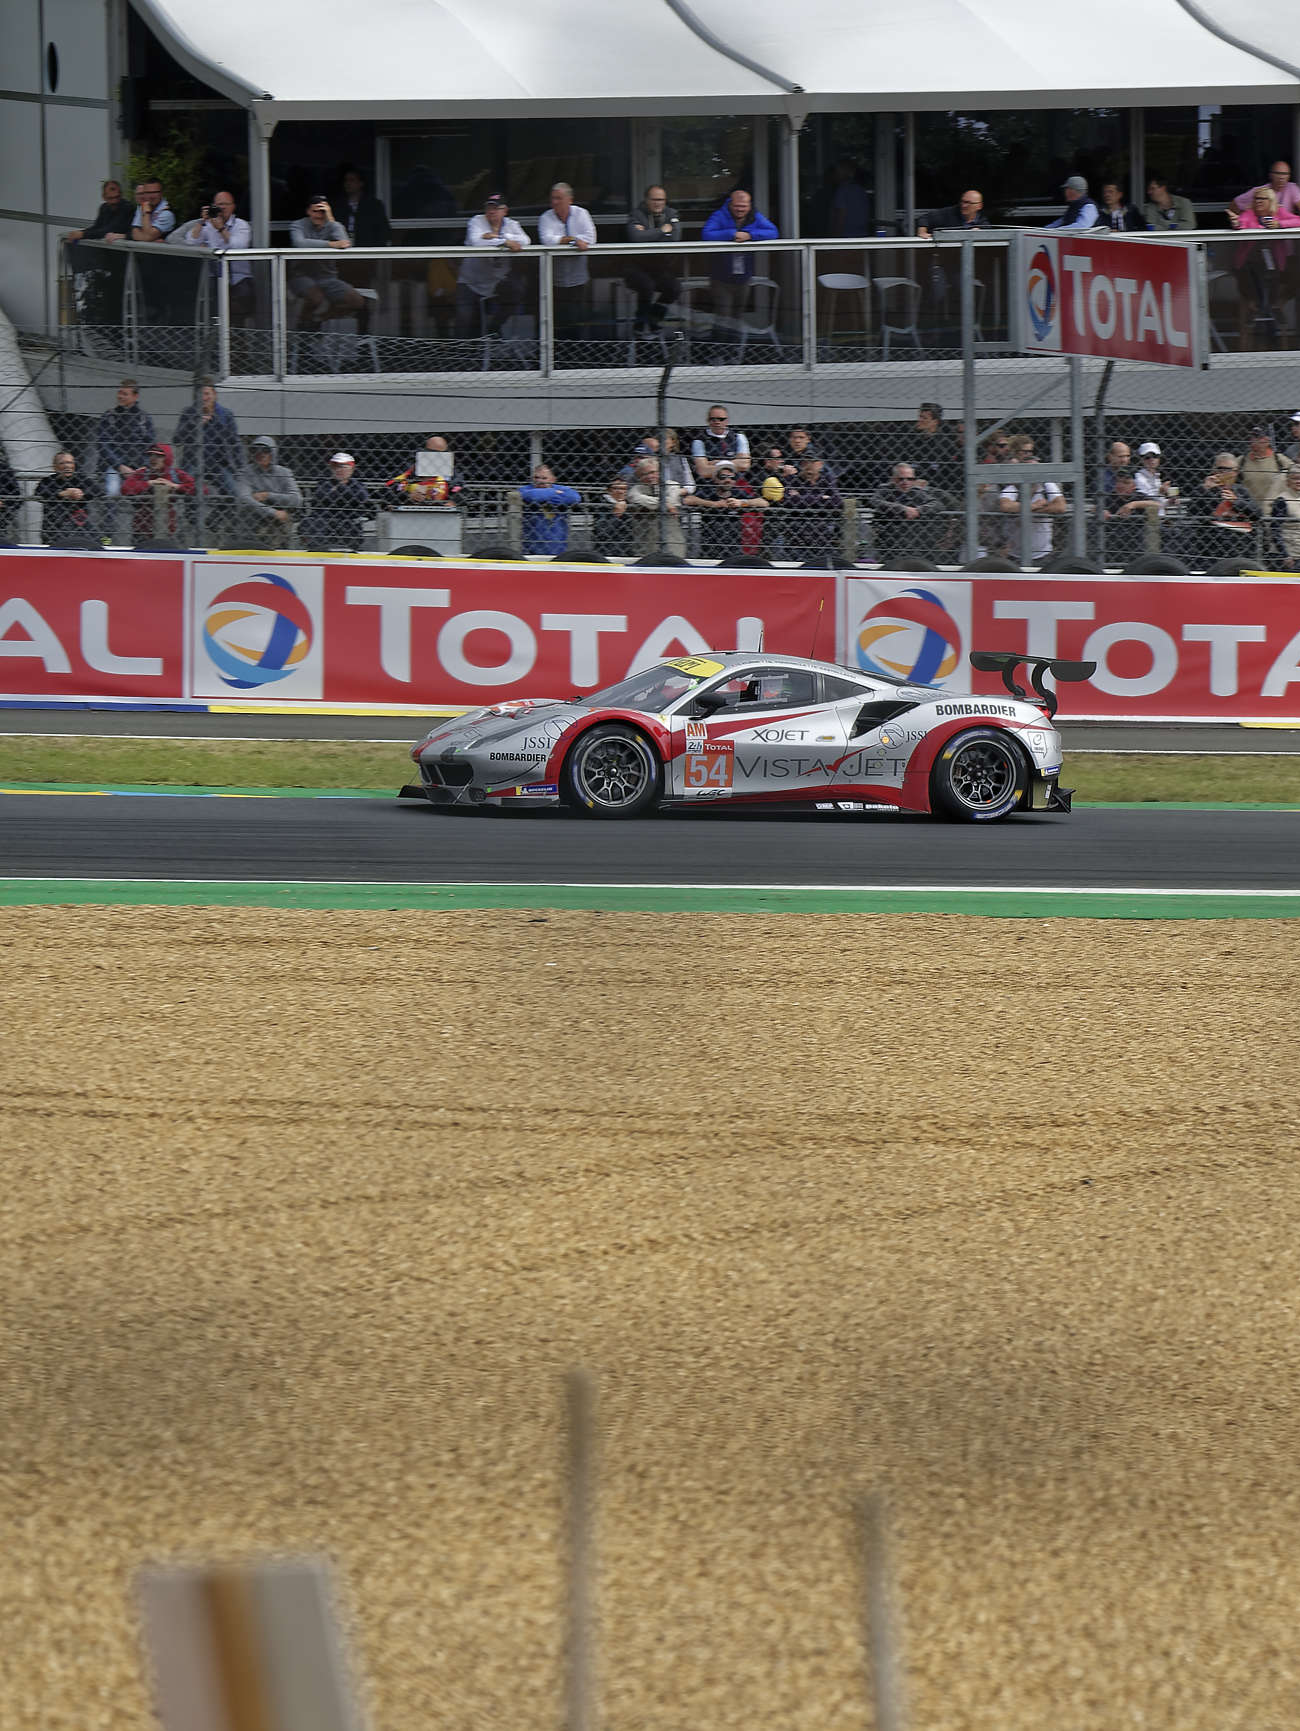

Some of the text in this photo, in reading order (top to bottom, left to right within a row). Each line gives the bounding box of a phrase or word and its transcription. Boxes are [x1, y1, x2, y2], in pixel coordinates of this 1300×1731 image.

[1063, 254, 1189, 348] TOTAL
[936, 704, 1016, 717] BOMBARDIER
[687, 722, 706, 737] AM
[751, 729, 810, 743] XOJET
[521, 736, 551, 751] JSSI
[705, 743, 733, 751] TOTAL
[490, 752, 547, 762] BOMBARDIER
[689, 755, 728, 787] 54
